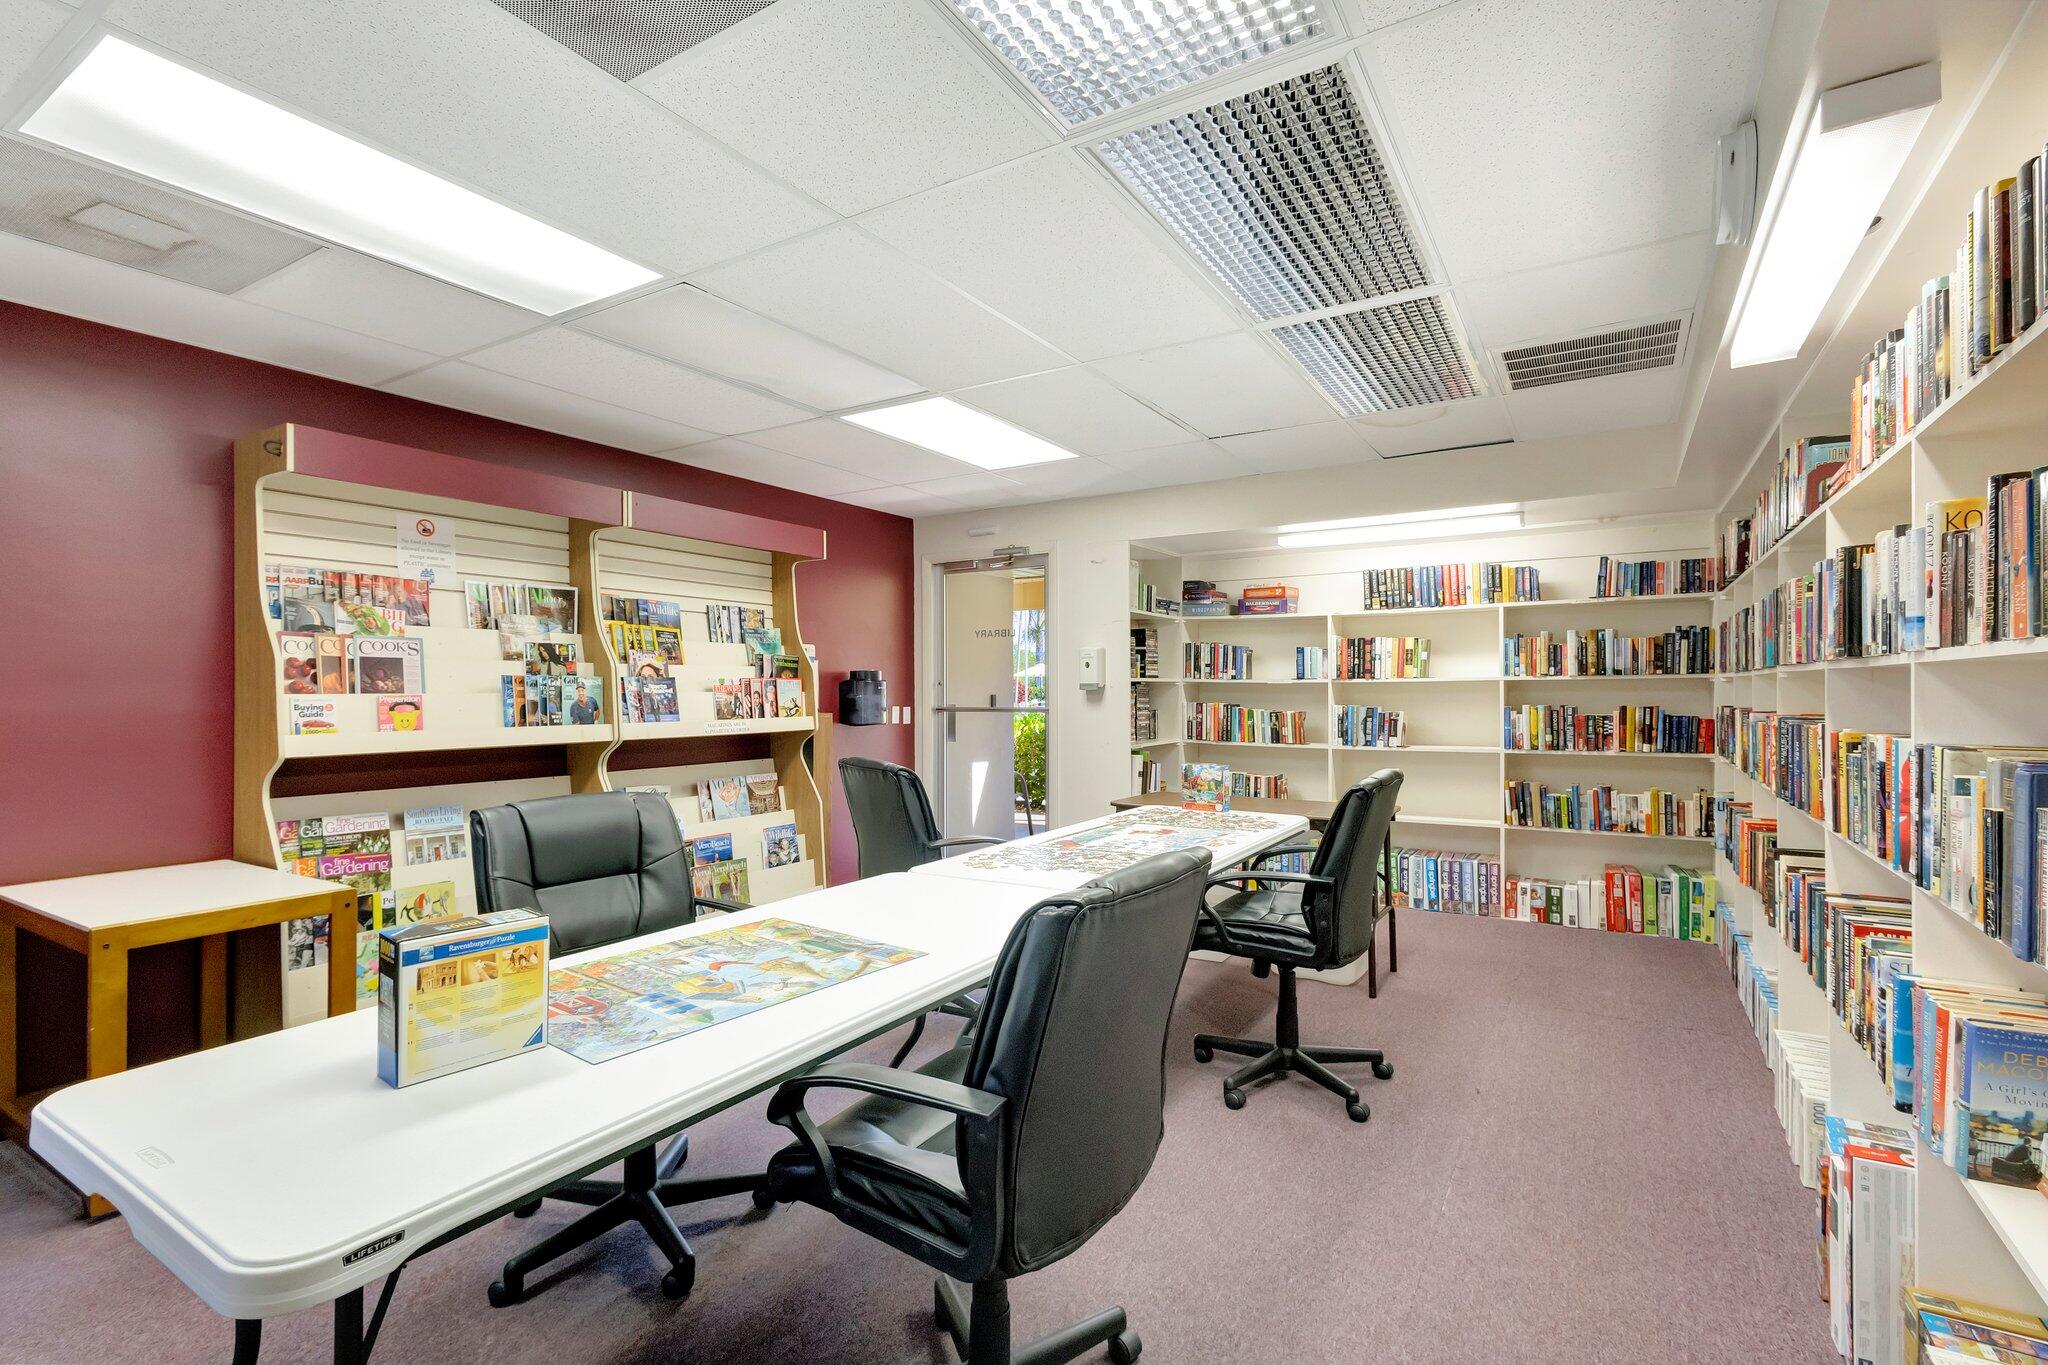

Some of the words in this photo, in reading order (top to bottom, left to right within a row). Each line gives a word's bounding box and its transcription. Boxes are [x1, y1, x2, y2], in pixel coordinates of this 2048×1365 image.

[1828, 448, 1850, 460] JOHN
[1926, 517, 1934, 566] KOONTZ
[1986, 565, 1994, 596] TRUTH
[648, 604, 678, 616] Wildlife
[294, 704, 324, 712] Buying
[407, 809, 438, 818] Southern
[439, 806, 462, 817] Living
[325, 819, 386, 833] Gardening
[769, 829, 794, 838] Wildlife
[322, 860, 389, 876] Gardening
[448, 939, 490, 952] Ravensburger
[496, 934, 515, 942] Puzzle
[1935, 1025, 1943, 1054] DEBBIE
[2003, 1051, 2048, 1068] DEB
[1933, 1056, 1942, 1103] MACOMBER
[1999, 1085, 2037, 1097] Girl's
[350, 1234, 398, 1262] LIFETIME
